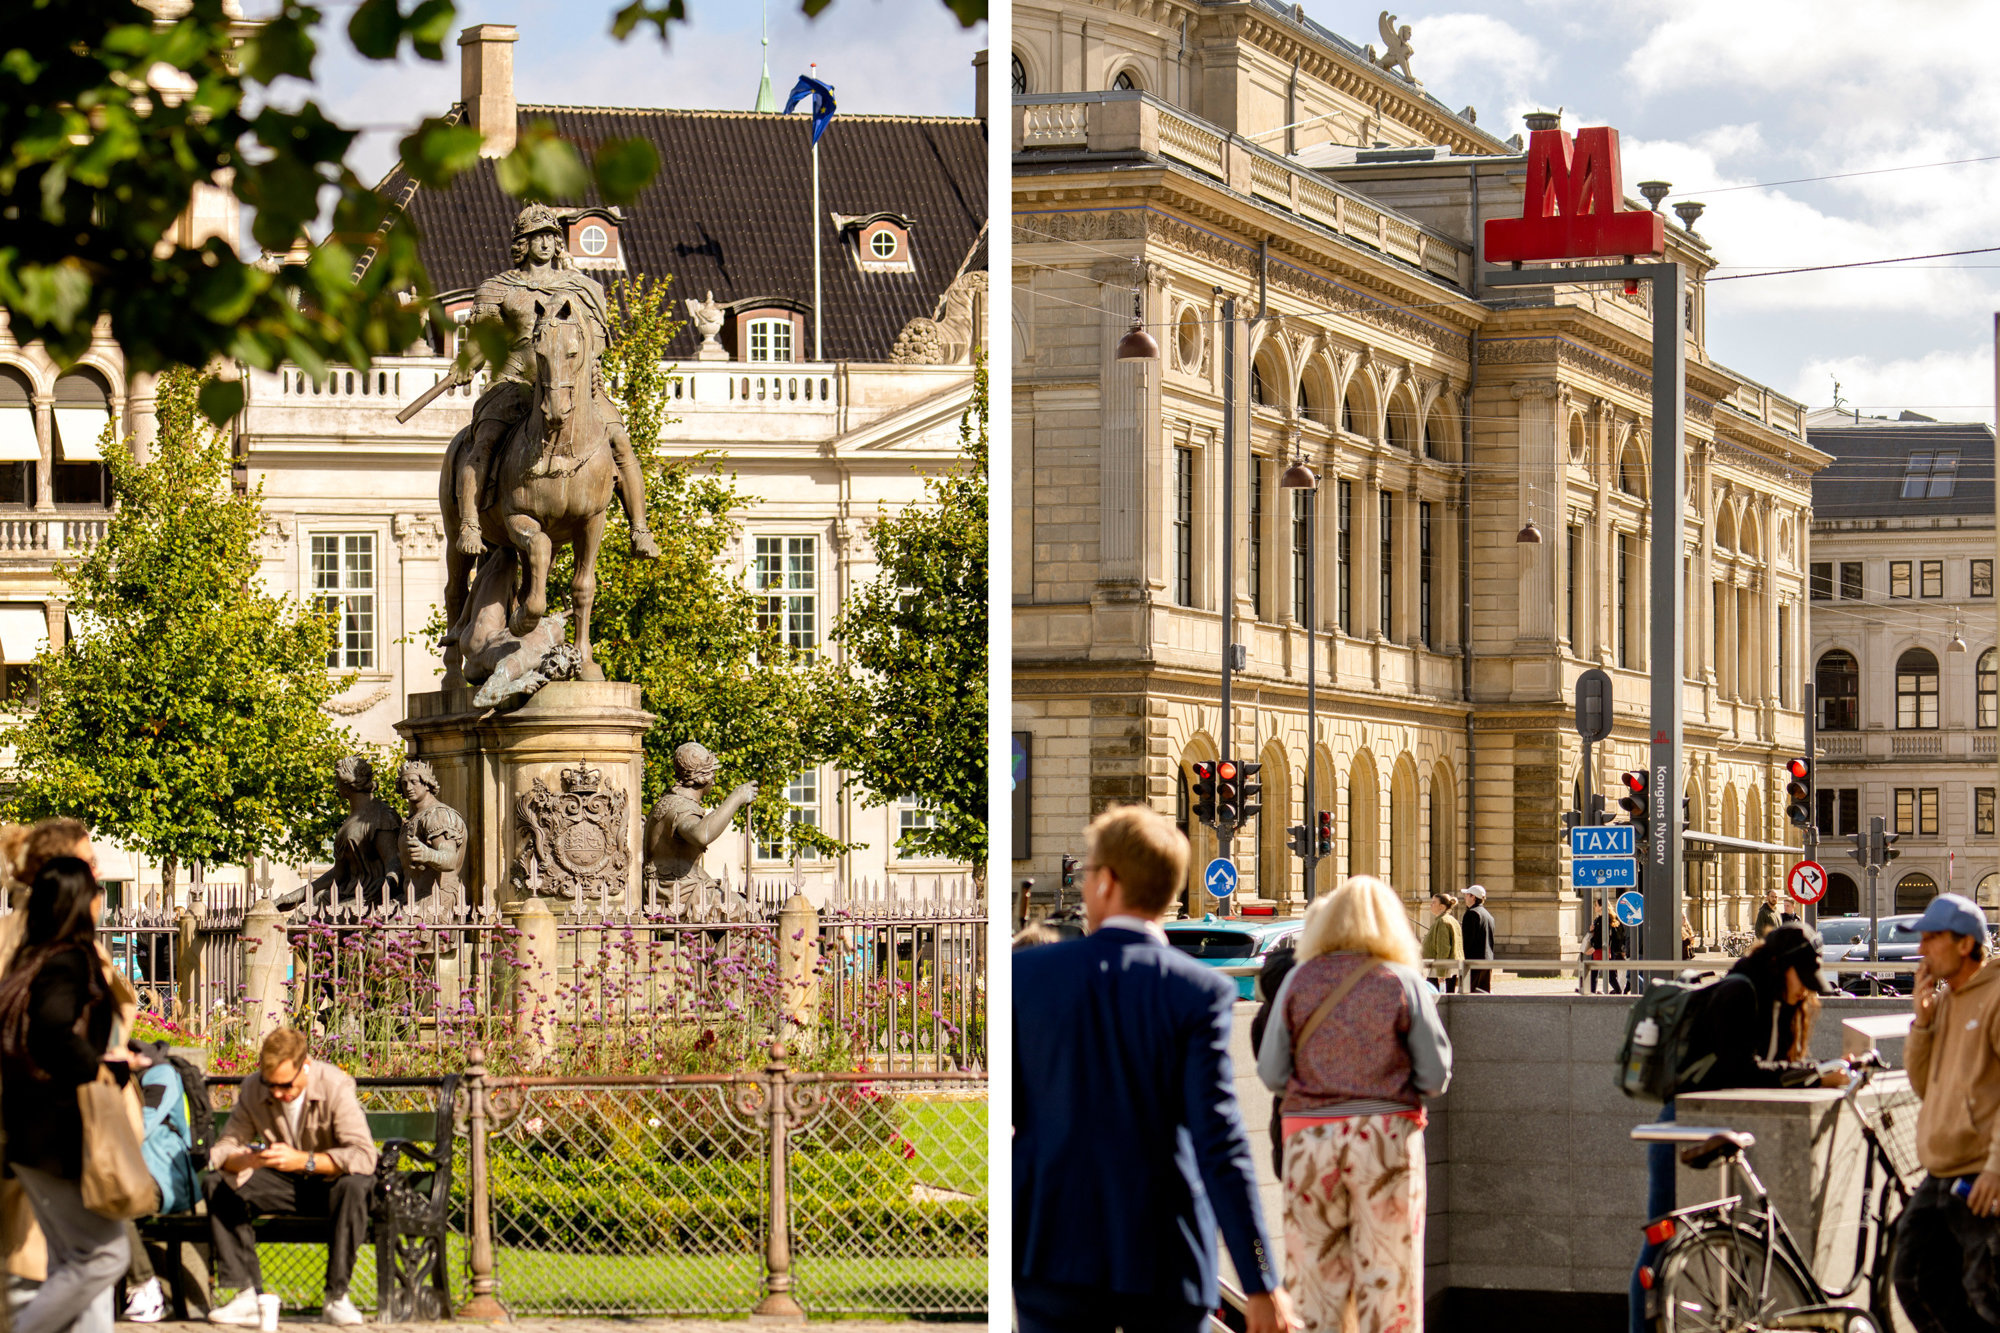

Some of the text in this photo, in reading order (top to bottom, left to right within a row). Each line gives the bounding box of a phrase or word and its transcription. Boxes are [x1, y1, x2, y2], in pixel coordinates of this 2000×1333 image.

[1654, 765, 1667, 865] Kongens Nytorv
[1575, 831, 1627, 850] TAXI
[1578, 866, 1628, 879] 6 vogne
